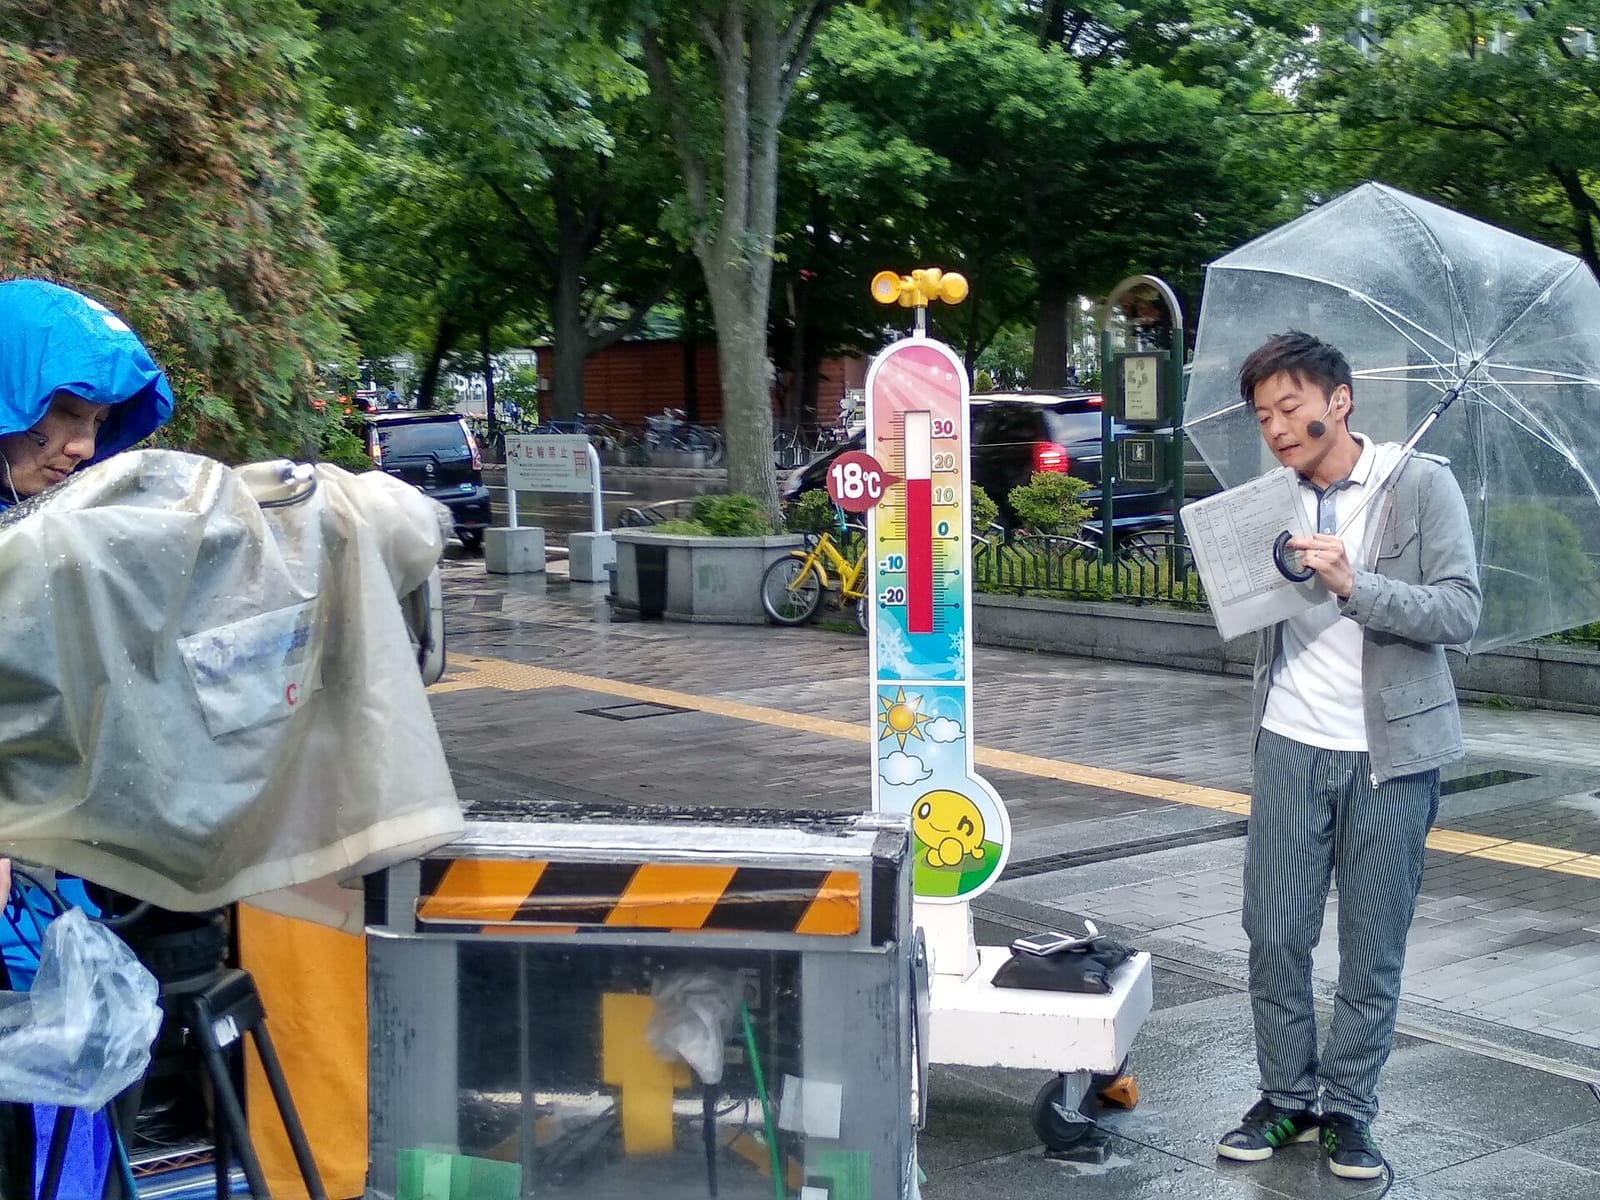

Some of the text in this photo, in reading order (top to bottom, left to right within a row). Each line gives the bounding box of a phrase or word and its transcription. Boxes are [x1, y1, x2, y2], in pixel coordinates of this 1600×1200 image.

[934, 420, 953, 435] 30
[934, 454, 954, 469] 20
[935, 488, 954, 502] 10
[937, 521, 949, 536] 0
[880, 555, 904, 570] -10
[880, 589, 904, 603] -20
